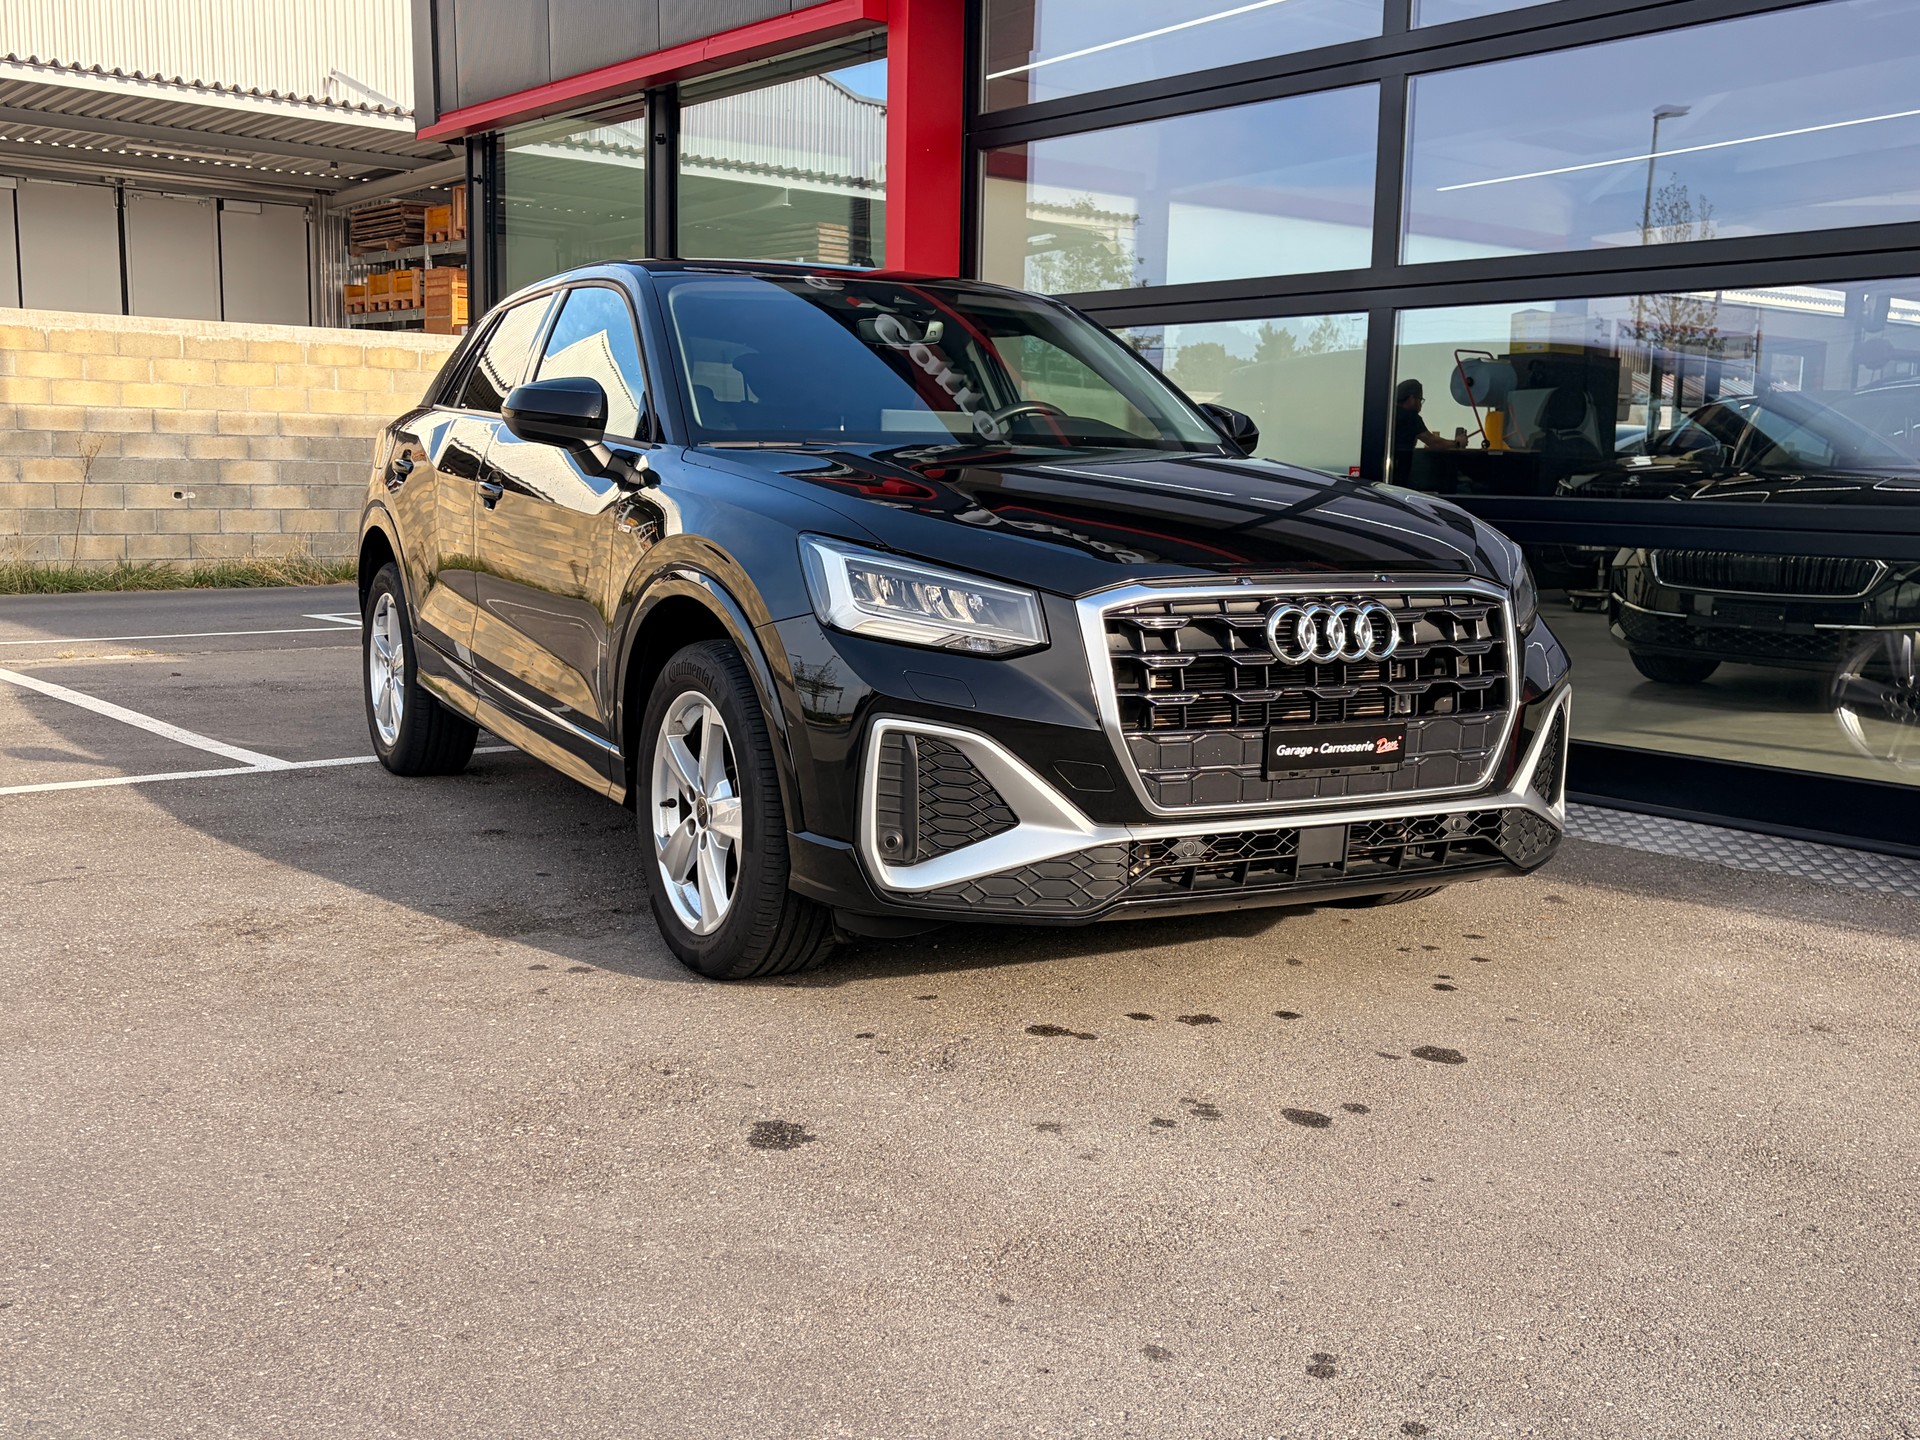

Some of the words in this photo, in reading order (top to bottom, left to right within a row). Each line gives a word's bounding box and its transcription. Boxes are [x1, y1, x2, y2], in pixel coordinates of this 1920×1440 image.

[668, 658, 715, 691] Continental
[1276, 744, 1313, 757] Garage
[1320, 740, 1375, 754] Carrosserie
